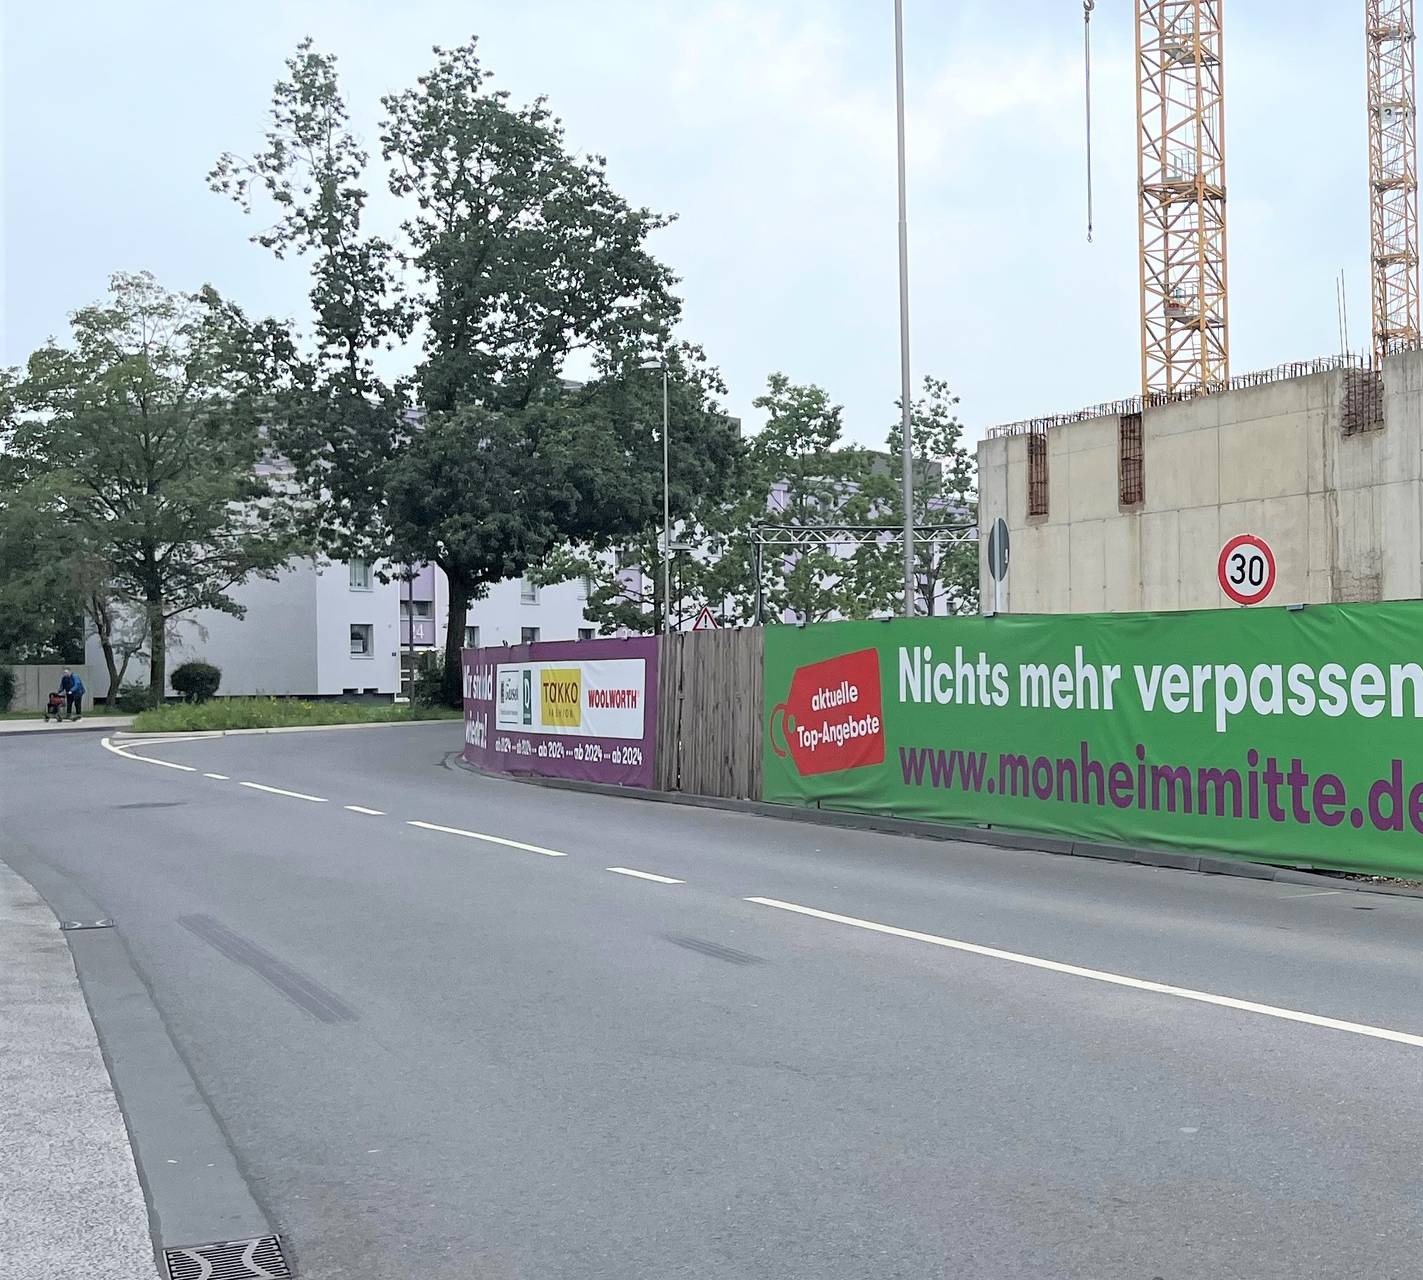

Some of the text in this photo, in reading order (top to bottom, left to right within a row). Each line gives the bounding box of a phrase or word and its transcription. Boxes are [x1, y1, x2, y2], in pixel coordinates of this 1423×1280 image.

[1230, 553, 1264, 587] 30
[899, 646, 1010, 707] Nichts
[1019, 645, 1121, 710] mehr
[588, 689, 637, 708] WOOLWORTH
[811, 681, 859, 711] aktuelle
[797, 714, 880, 751] Top-Angebote
[612, 746, 642, 765] ab 2024
